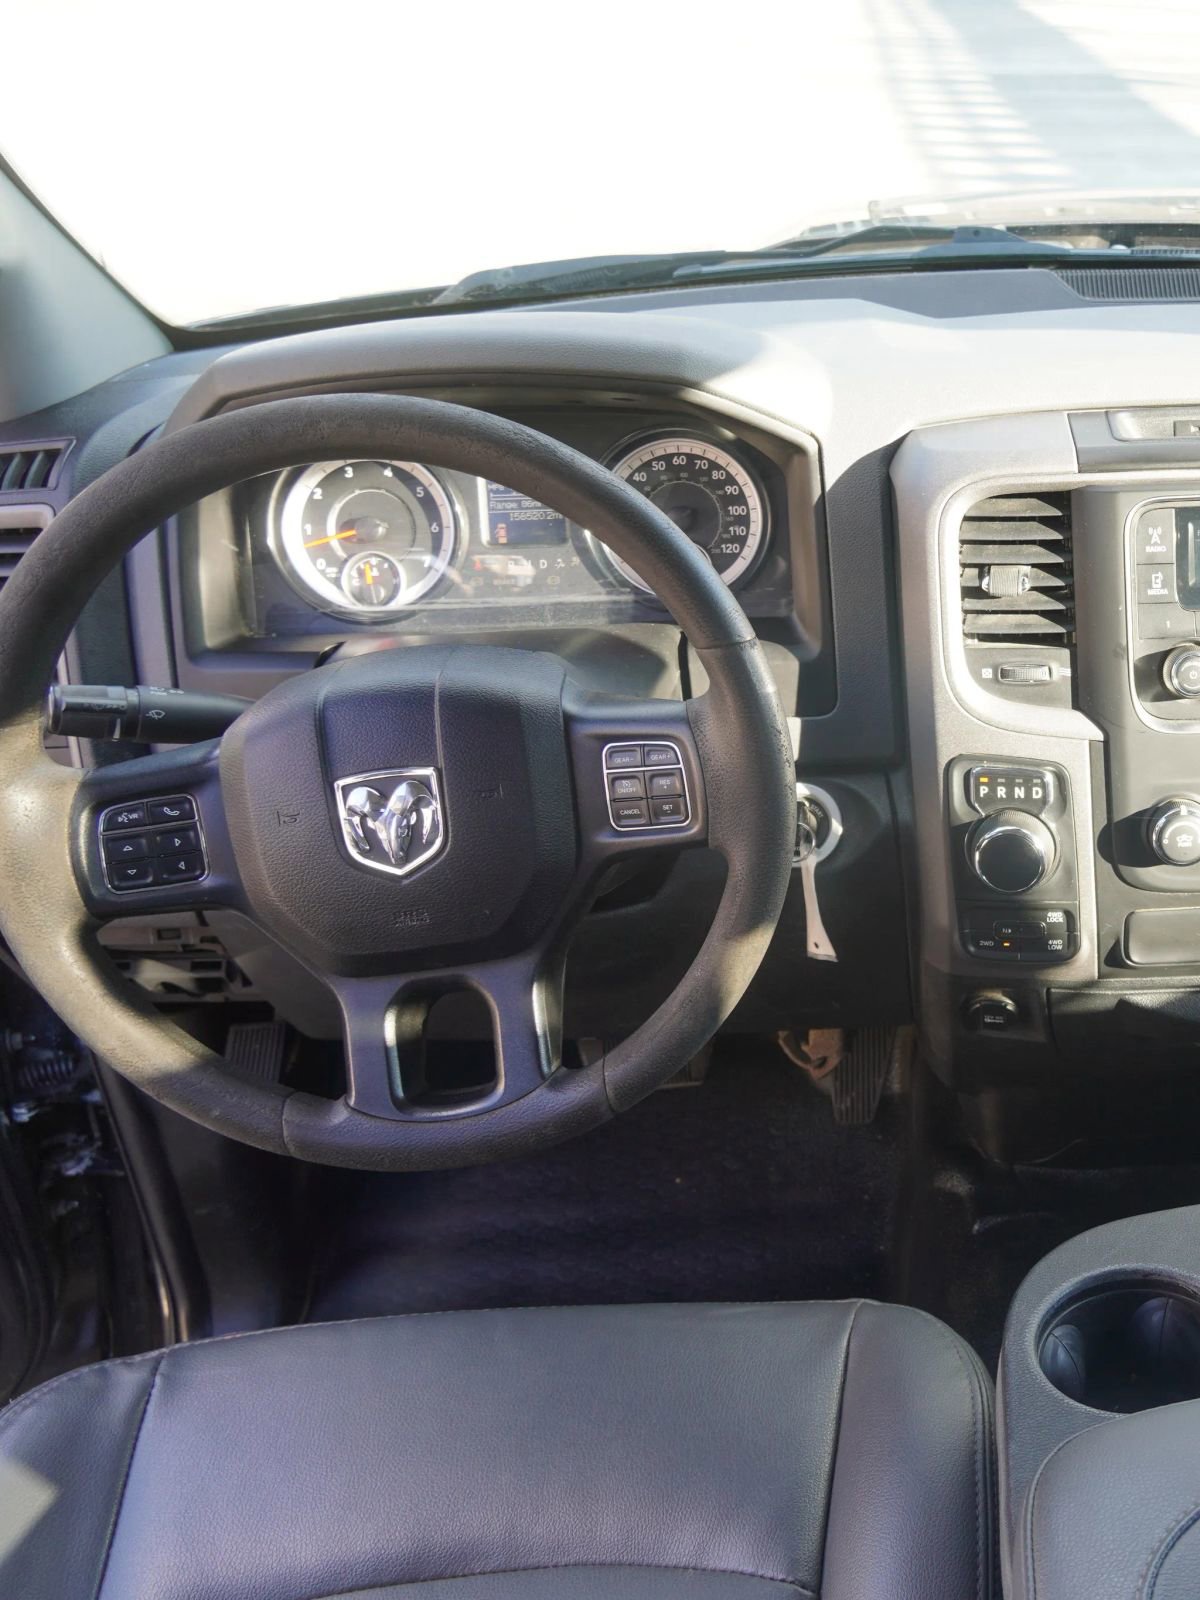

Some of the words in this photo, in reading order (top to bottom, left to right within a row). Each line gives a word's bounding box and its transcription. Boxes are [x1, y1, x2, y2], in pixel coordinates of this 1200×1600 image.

[672, 455, 687, 465] 60
[694, 460, 708, 470] 70
[651, 461, 666, 471] 50
[344, 467, 354, 478] 3
[383, 467, 393, 478] 4
[632, 472, 647, 482] 40
[711, 470, 726, 480] 80
[313, 489, 323, 500] 2
[416, 487, 425, 498] 5
[725, 486, 739, 495] 90
[728, 506, 747, 516] 100
[304, 524, 312, 535] 1
[431, 523, 439, 533] 6
[729, 526, 746, 536] 110
[721, 544, 740, 554] 120
[316, 559, 326, 570] 0
[423, 556, 431, 567] 7
[540, 560, 547, 568] D
[1166, 620, 1170, 629] 1
[980, 786, 989, 798] P
[997, 786, 1006, 799] R
[1014, 786, 1025, 799] N
[1032, 787, 1042, 799] D
[811, 804, 823, 817] START
